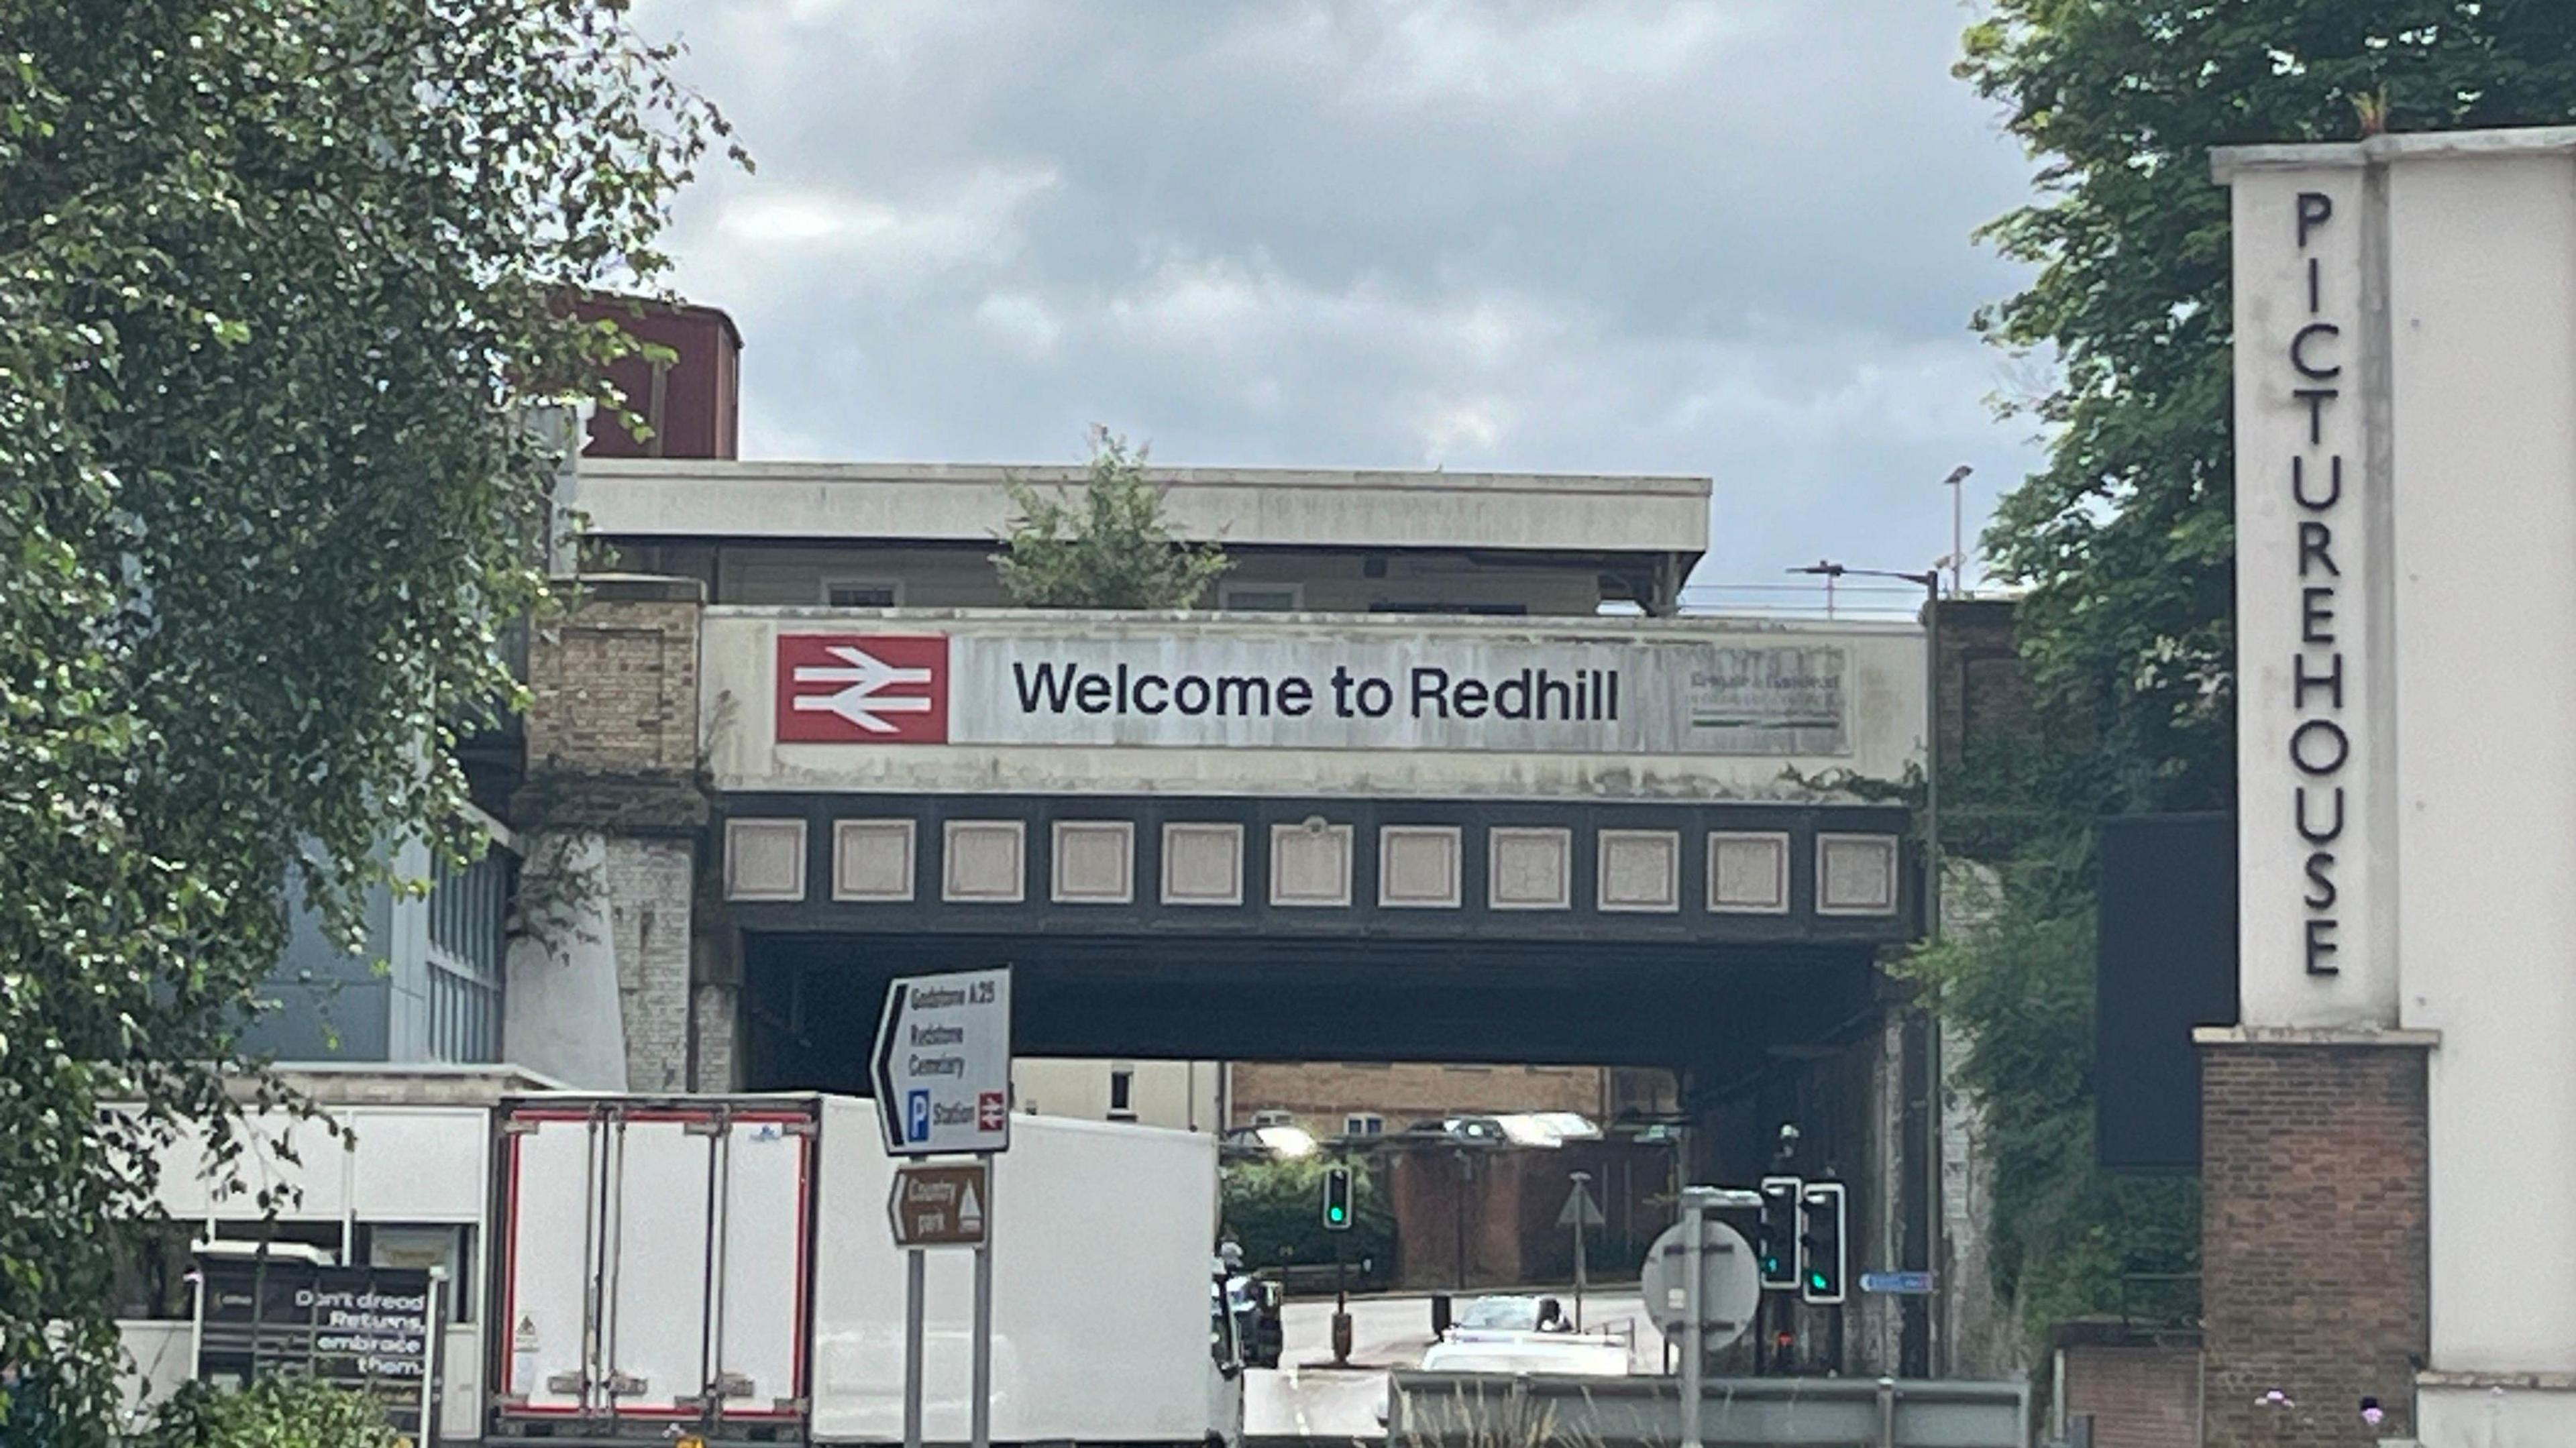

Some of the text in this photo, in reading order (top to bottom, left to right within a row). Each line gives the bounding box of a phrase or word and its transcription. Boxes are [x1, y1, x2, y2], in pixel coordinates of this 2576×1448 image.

[2289, 191, 2349, 977] PICTUREHOUSE
[1014, 662, 1619, 721] Welcome to Redhill
[933, 1101, 975, 1125] Station
[295, 1289, 425, 1311] Don't dread
[317, 1335, 421, 1353] embrace
